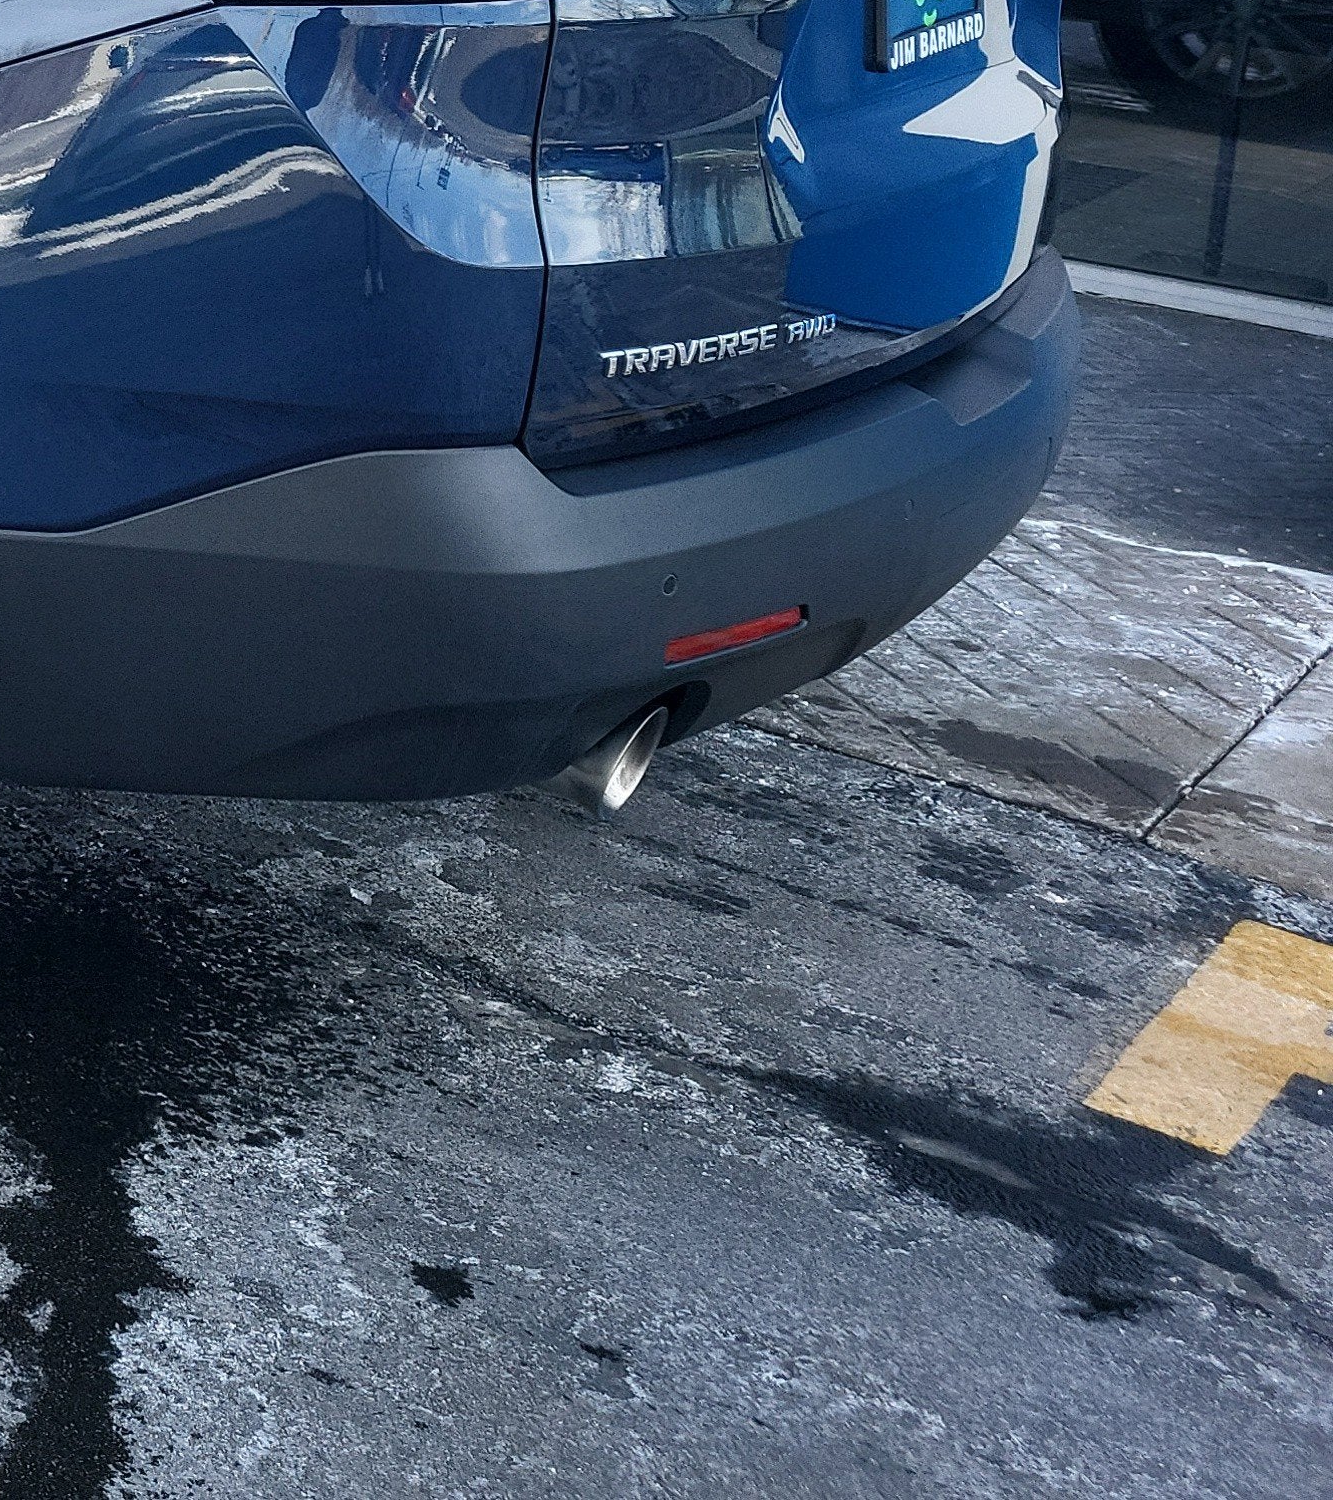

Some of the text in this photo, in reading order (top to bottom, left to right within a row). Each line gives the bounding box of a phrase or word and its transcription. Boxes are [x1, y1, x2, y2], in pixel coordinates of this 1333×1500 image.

[890, 13, 984, 70] JIM BARNARD
[600, 313, 838, 378] TRAVERSE AWD
